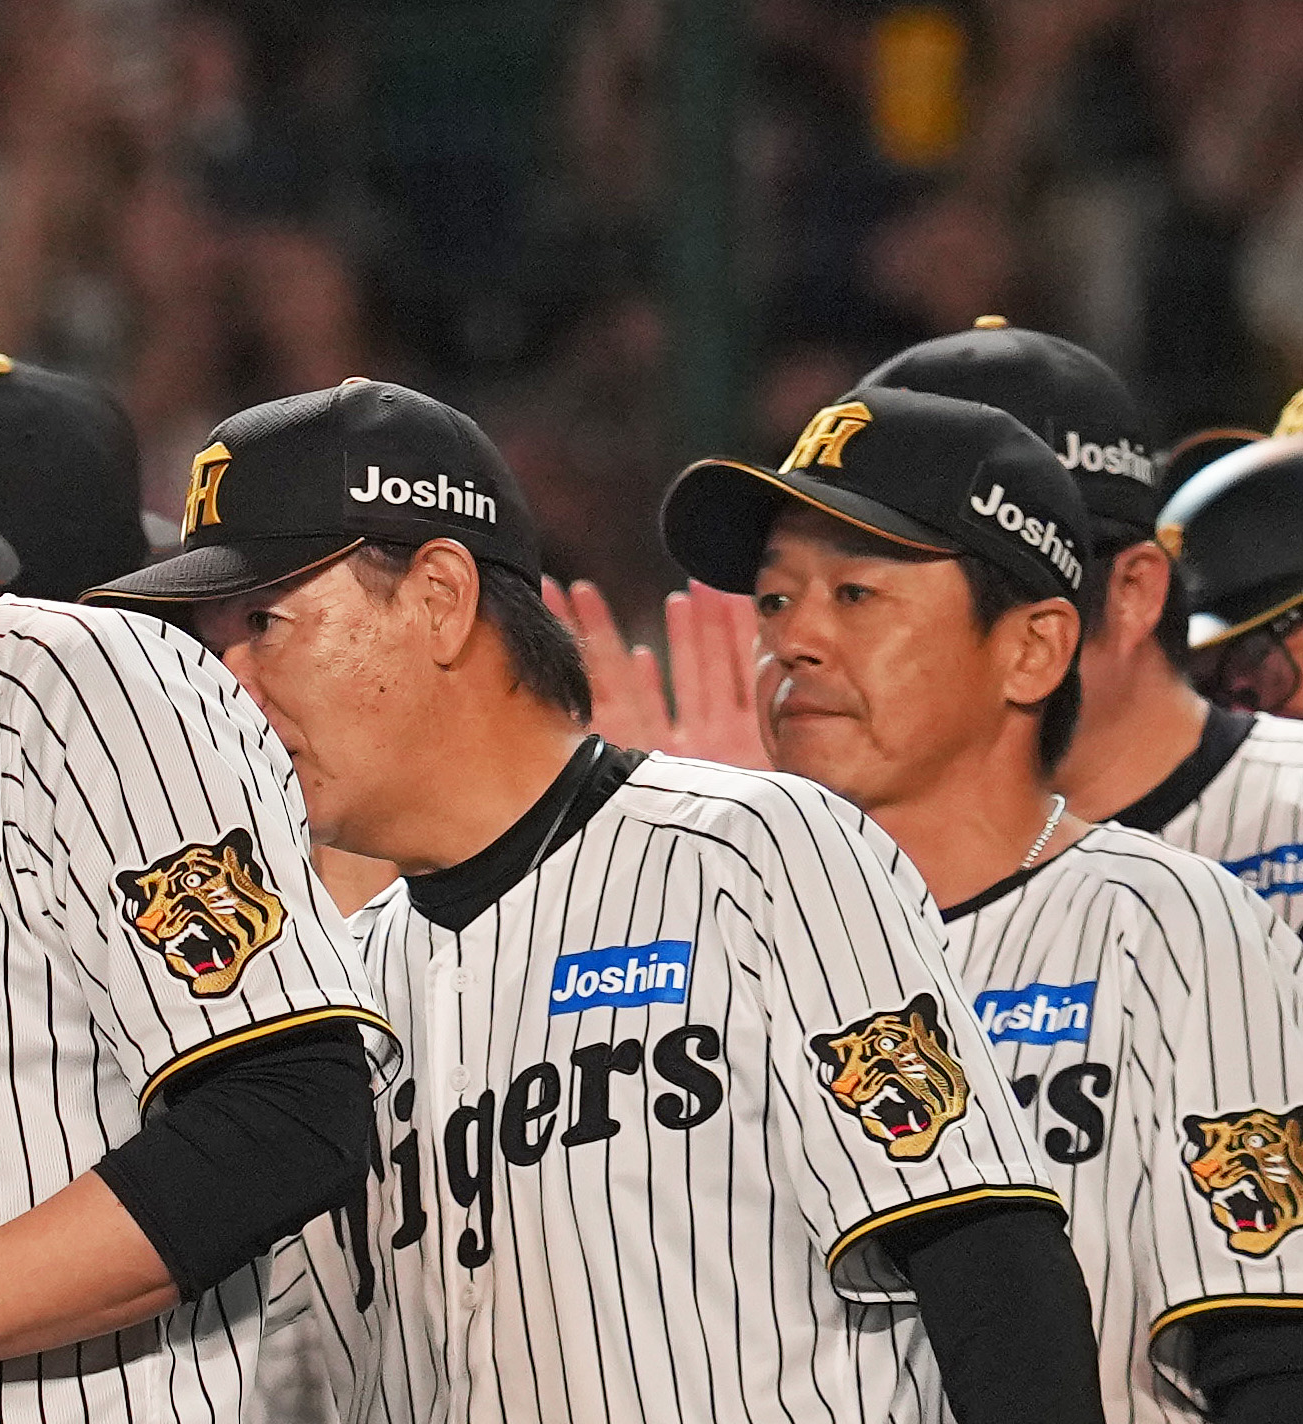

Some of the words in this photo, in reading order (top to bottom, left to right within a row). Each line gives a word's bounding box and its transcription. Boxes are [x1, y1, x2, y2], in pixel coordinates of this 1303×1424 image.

[349, 465, 497, 524] Joshin
[970, 483, 1084, 591] Joshin
[552, 954, 685, 1003] Joshin
